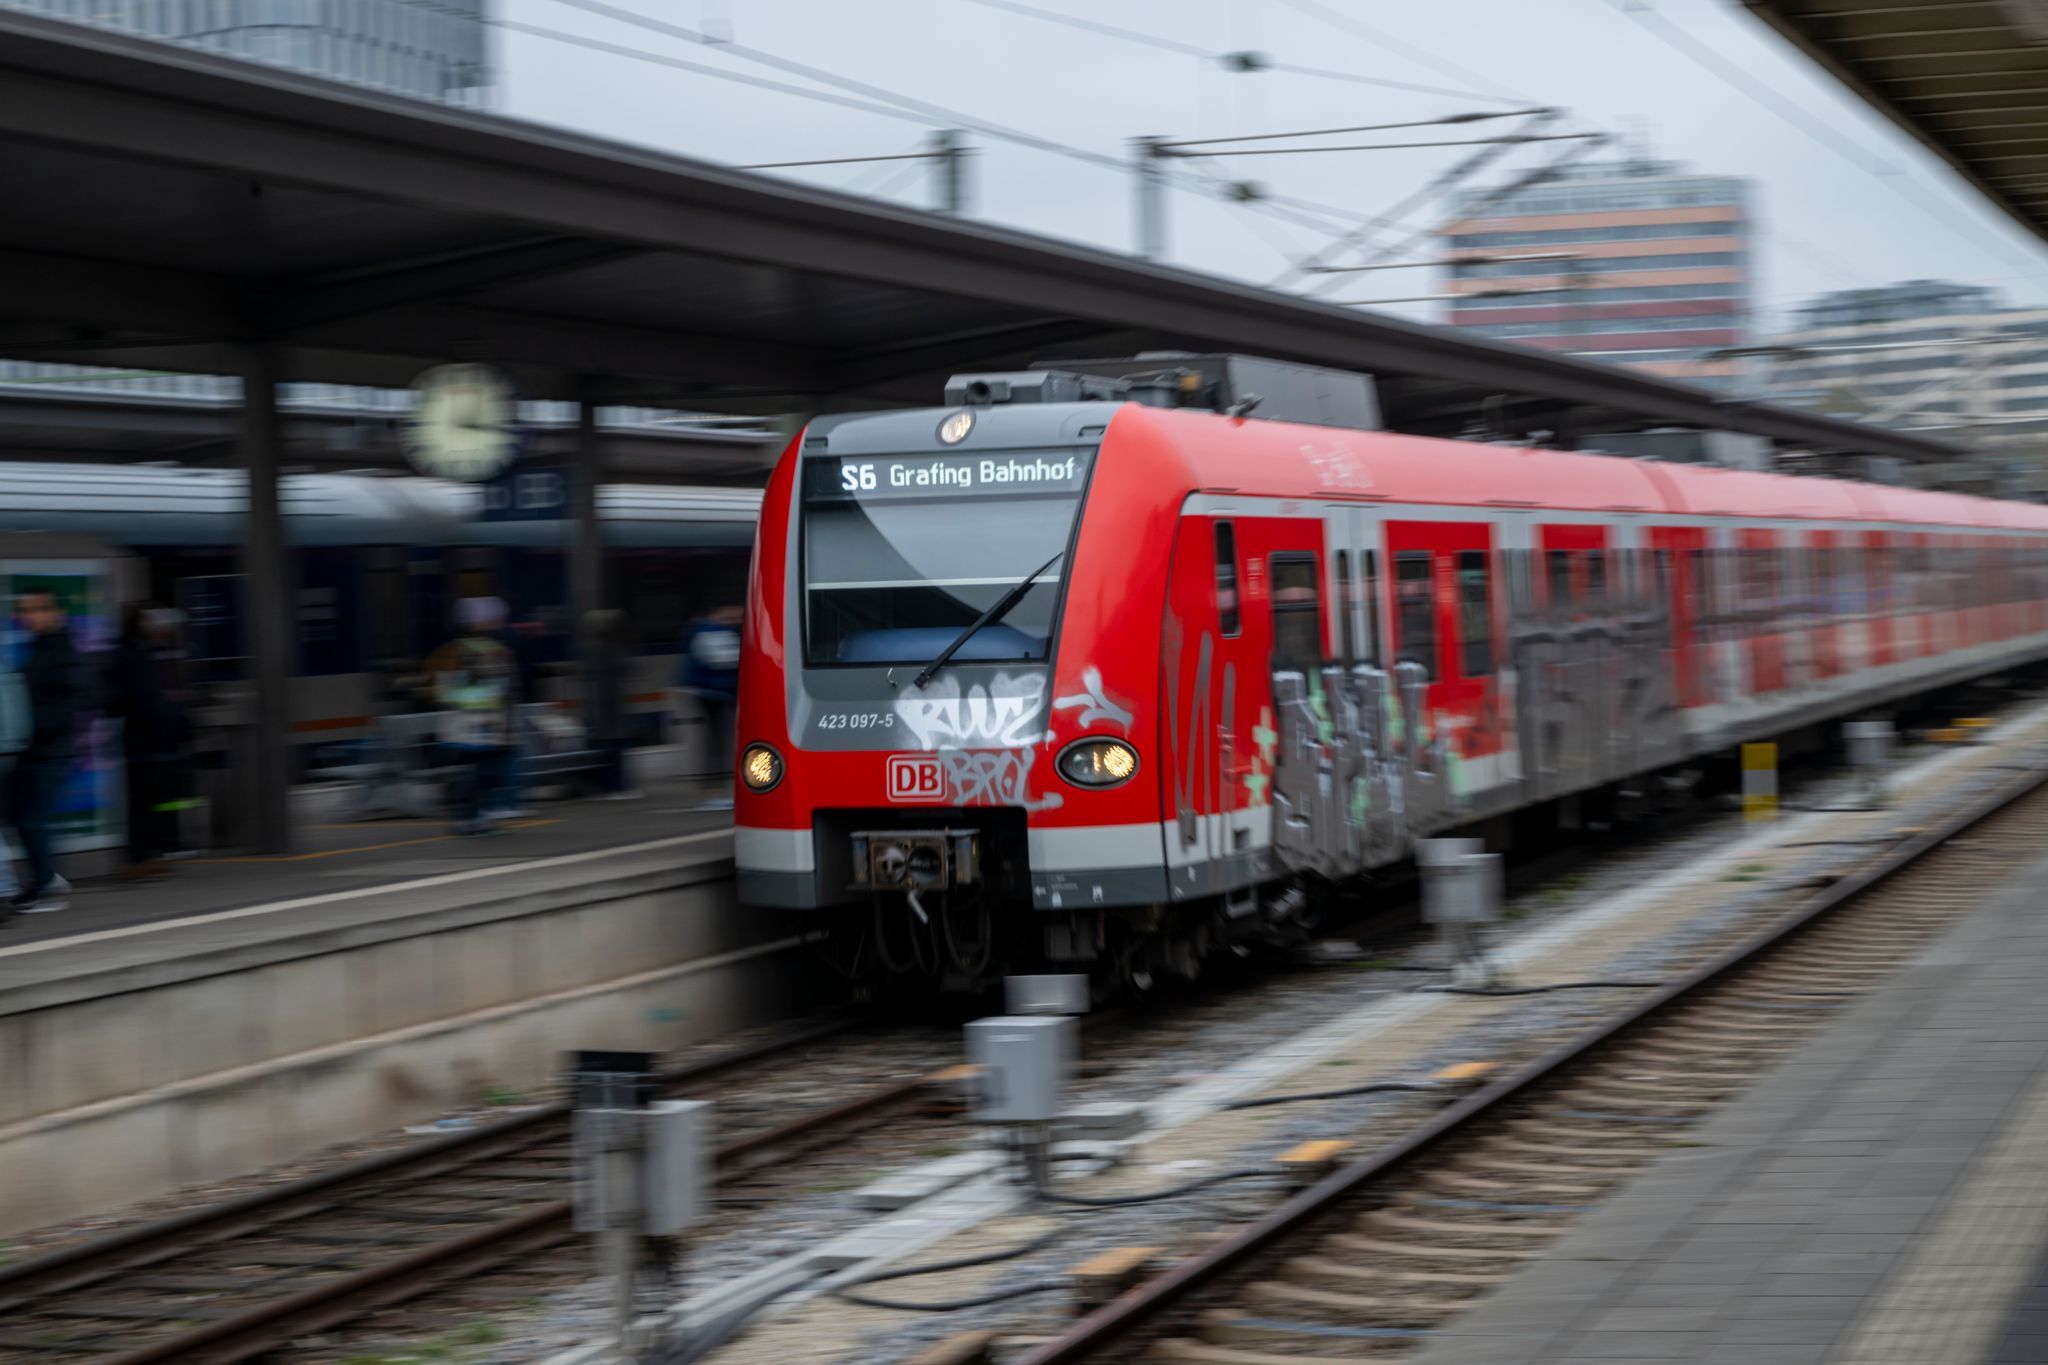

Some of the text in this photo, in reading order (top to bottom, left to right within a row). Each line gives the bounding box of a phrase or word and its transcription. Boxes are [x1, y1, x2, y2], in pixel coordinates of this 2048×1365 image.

[841, 456, 1075, 490] S6 Grafing Bahnhof
[818, 713, 894, 729] 423 097-5
[895, 764, 939, 792] DB
